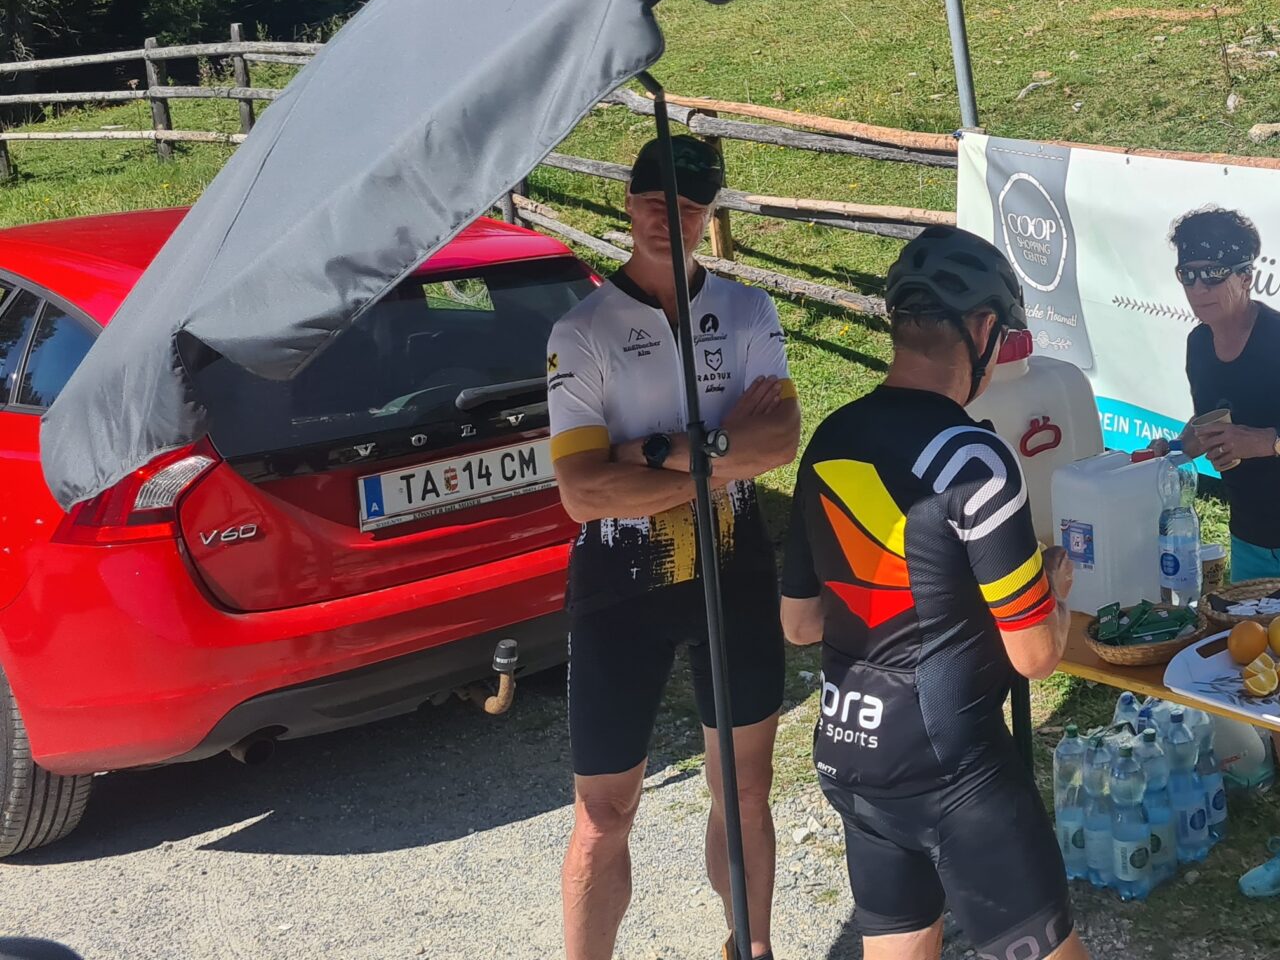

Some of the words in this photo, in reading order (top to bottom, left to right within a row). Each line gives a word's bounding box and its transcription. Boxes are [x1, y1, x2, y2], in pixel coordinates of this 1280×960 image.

[1007, 213, 1056, 241] COOP
[1016, 236, 1051, 255] SHOPPING
[1023, 250, 1048, 266] CENTER
[353, 413, 526, 458] VOLV
[400, 469, 441, 505] TA
[462, 457, 493, 491] 14
[500, 446, 538, 482] CM
[370, 502, 380, 513] A
[199, 523, 257, 545] V60
[826, 723, 879, 749] sports
